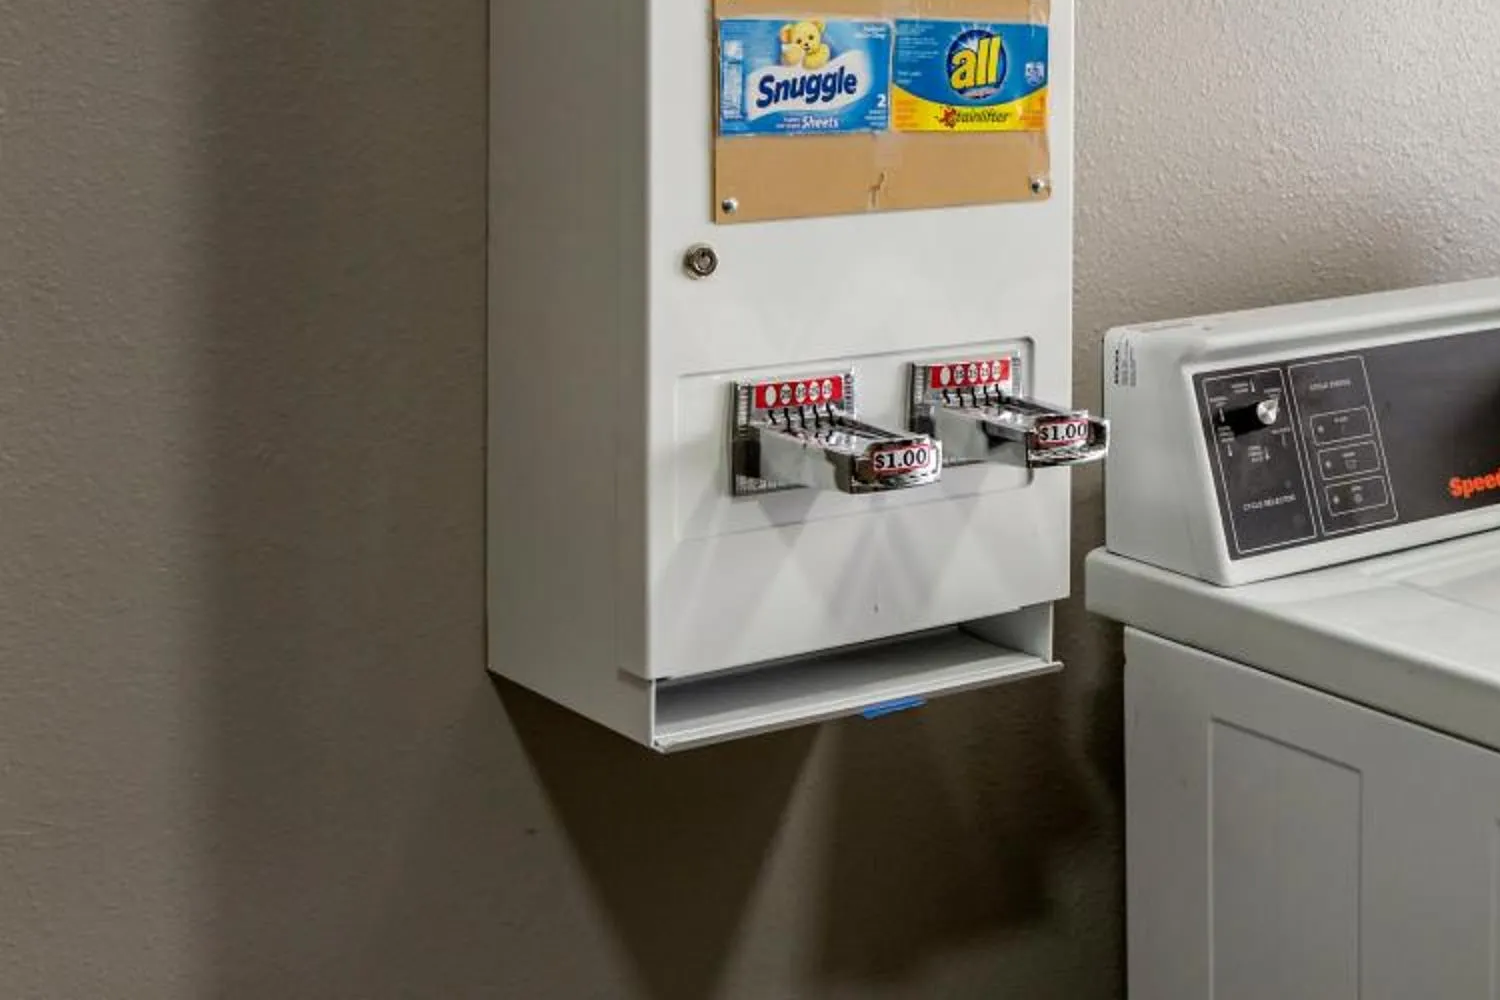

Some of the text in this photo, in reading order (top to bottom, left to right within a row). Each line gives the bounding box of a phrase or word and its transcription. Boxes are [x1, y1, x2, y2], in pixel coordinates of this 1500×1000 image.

[951, 35, 1001, 90] all
[756, 66, 857, 108] Snuggle
[877, 94, 888, 108] 2
[1039, 423, 1088, 441] $1.00
[875, 447, 927, 469] $1.00
